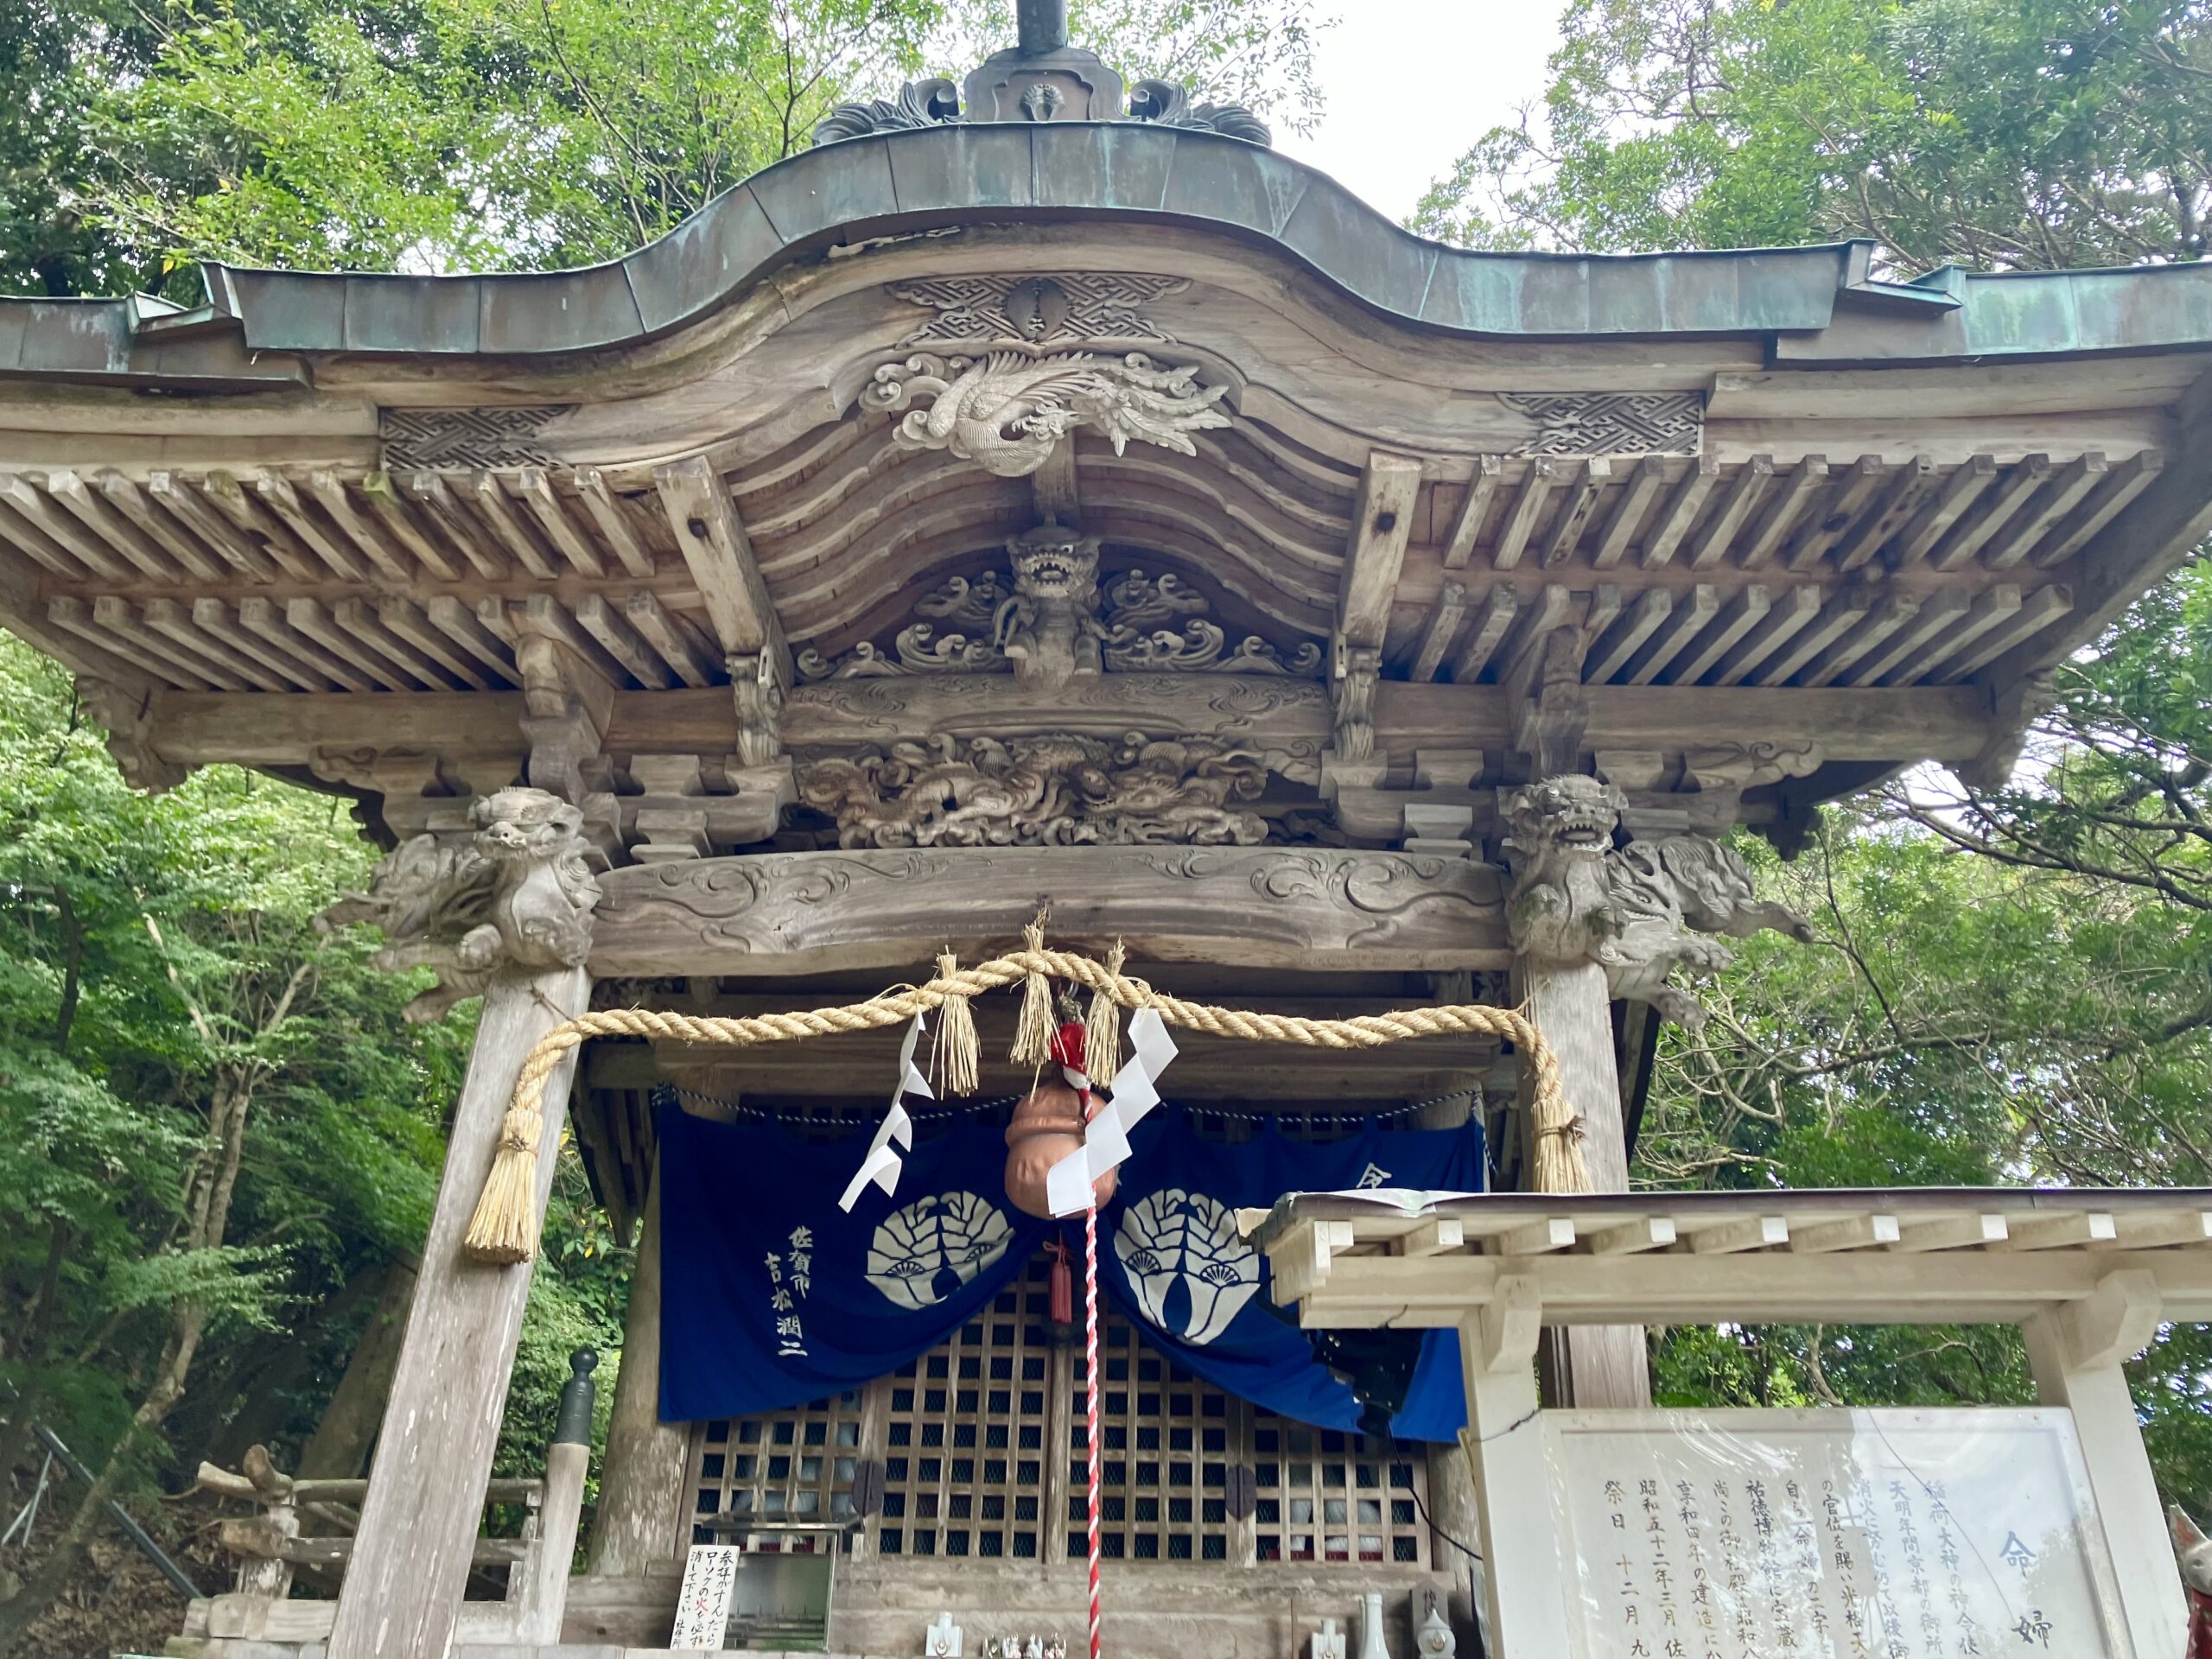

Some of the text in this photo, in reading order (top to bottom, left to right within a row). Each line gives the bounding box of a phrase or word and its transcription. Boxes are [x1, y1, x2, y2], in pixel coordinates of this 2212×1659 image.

[764, 1252, 808, 1357] 吉松潤二
[787, 1225, 814, 1300] 佐賀市
[681, 1550, 703, 1612] 消して下さい
[690, 1551, 718, 1649] ローソクの火を必ず
[707, 1549, 734, 1647] 参拝がすんだら
[1639, 1480, 1677, 1626] 昭和五十二年三月
[1821, 1480, 1870, 1659] の官位を賜い光格天
[1999, 1530, 2054, 1650] 命婦
